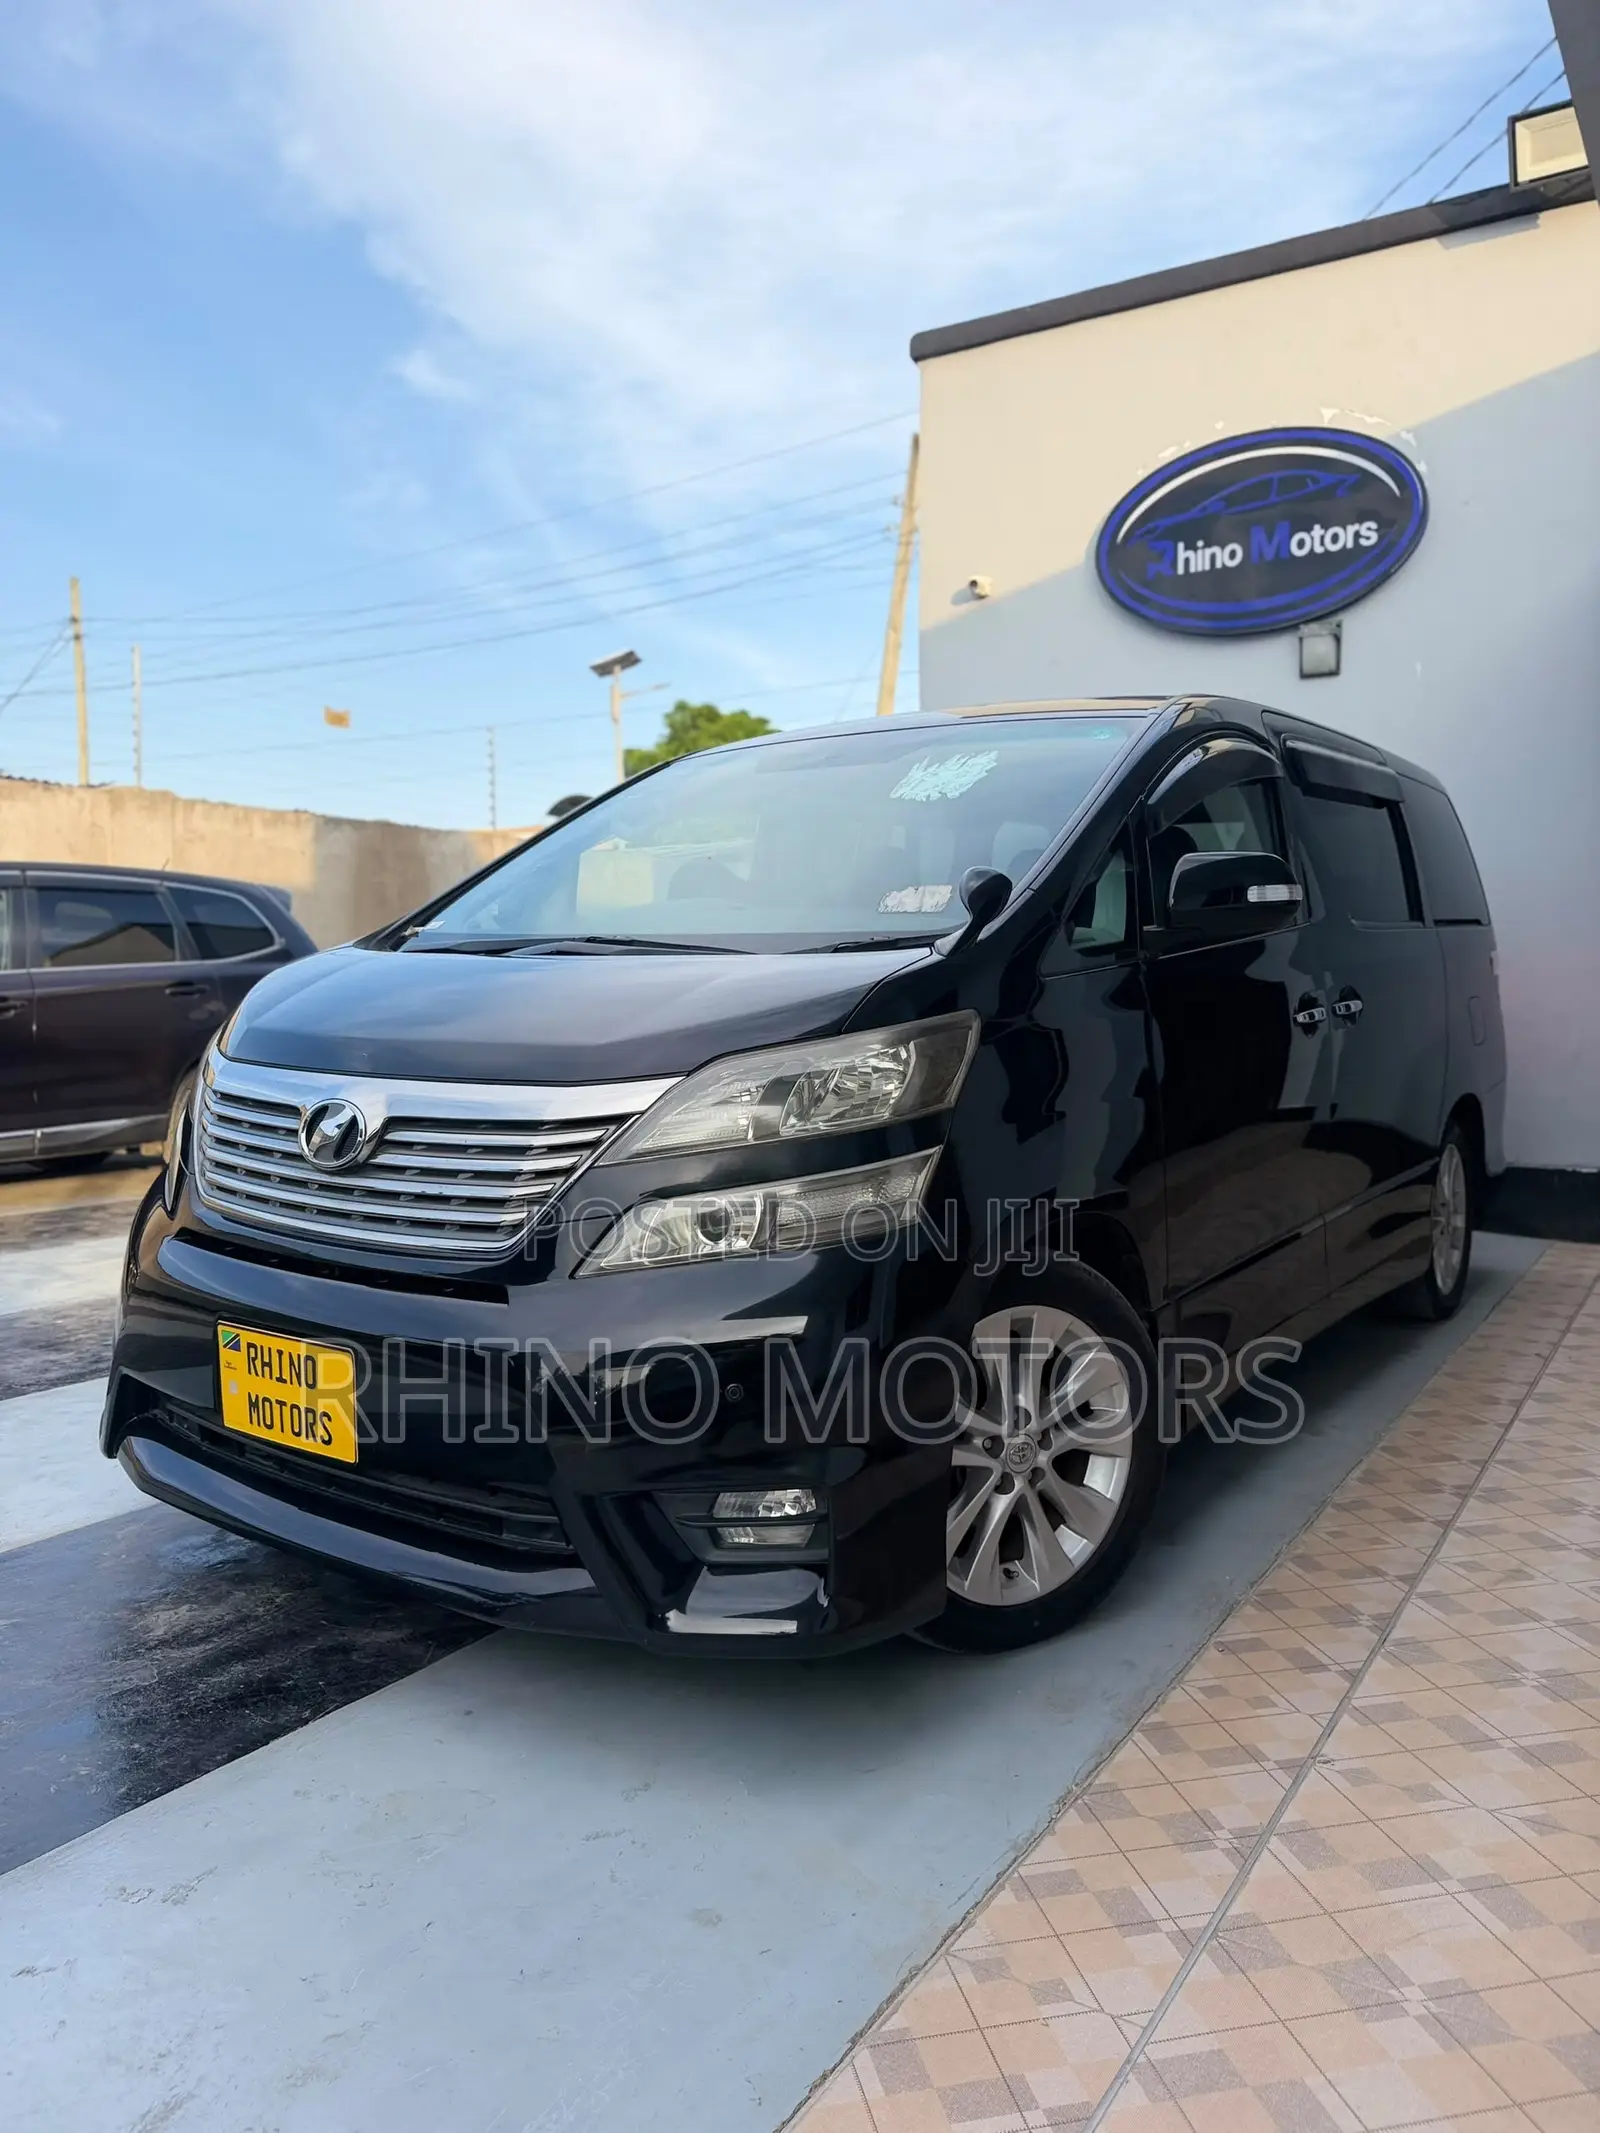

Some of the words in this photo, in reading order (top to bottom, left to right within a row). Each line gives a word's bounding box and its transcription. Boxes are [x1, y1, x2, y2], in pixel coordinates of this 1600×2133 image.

[1146, 539, 1243, 580] Rhino
[1250, 520, 1379, 564] Motors
[246, 1341, 318, 1390] RHINO
[247, 1391, 333, 1446] MOTORS
